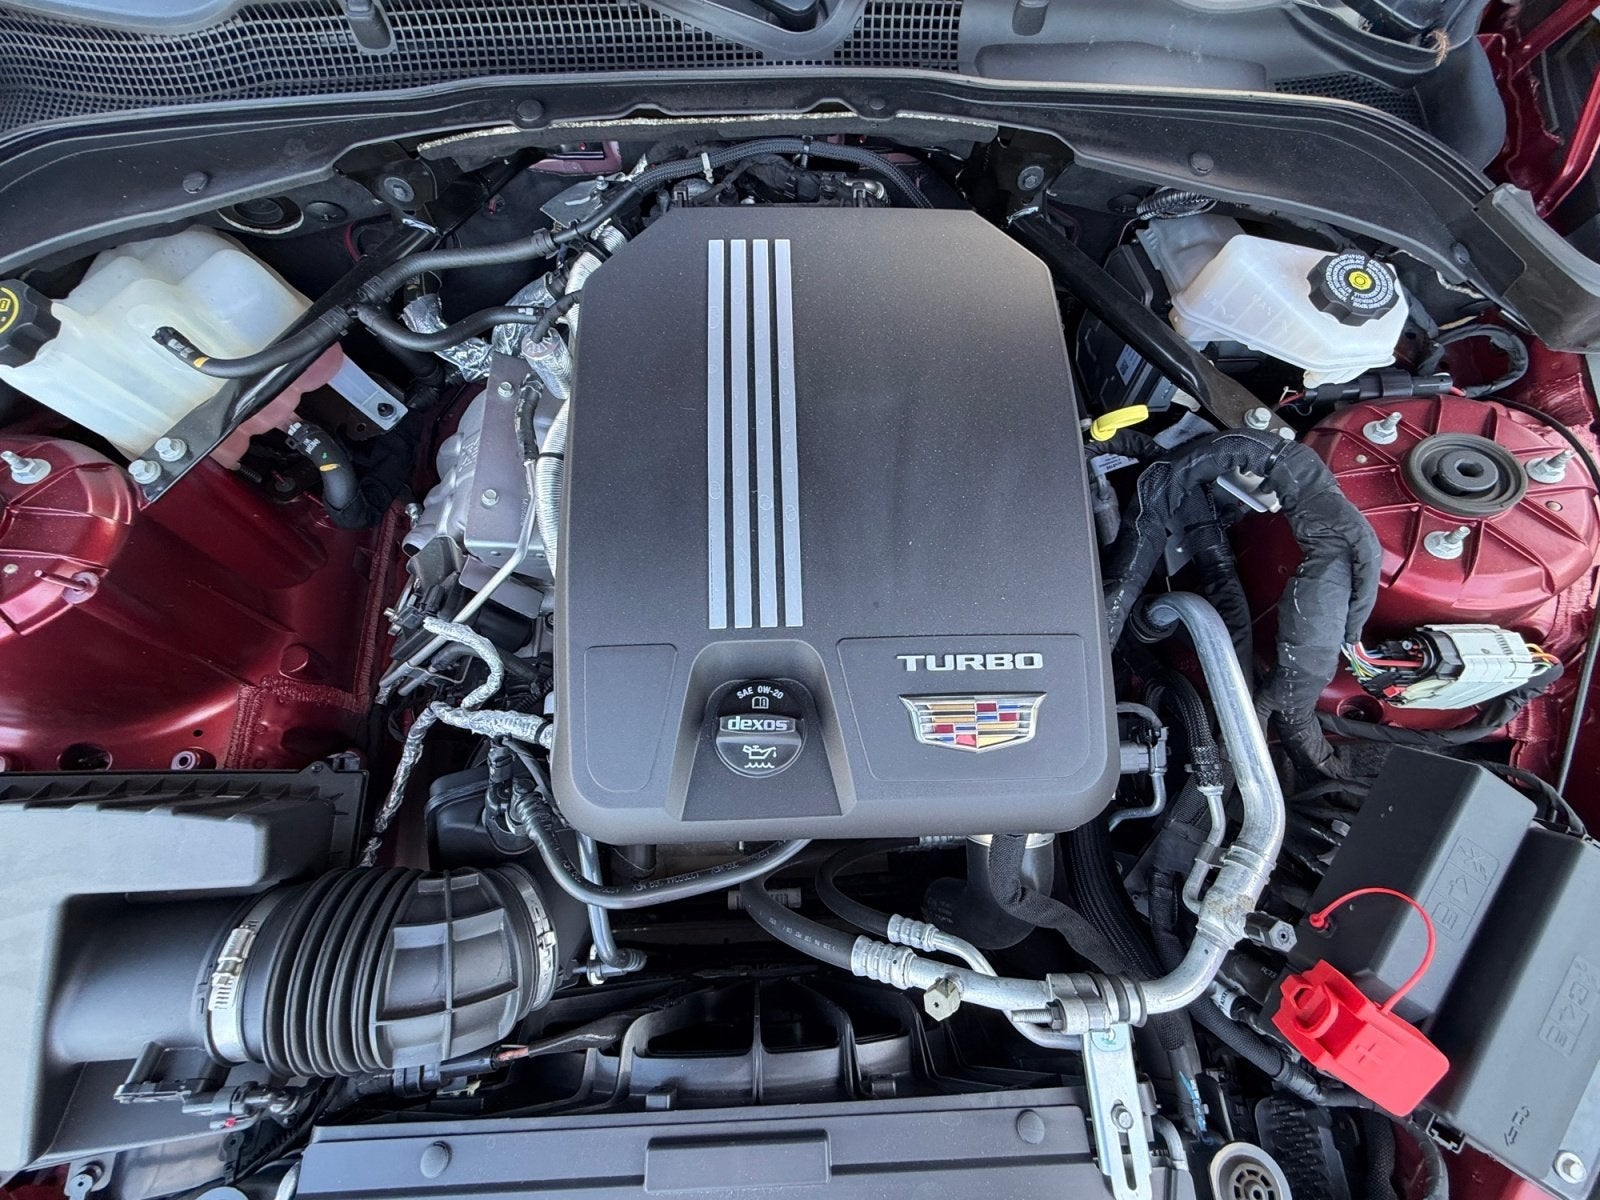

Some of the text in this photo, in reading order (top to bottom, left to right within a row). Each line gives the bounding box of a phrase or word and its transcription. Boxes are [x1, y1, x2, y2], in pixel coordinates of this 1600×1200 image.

[896, 653, 1044, 672] TURBO
[736, 685, 784, 699] SAE 0W-20
[727, 716, 788, 731] dexos
